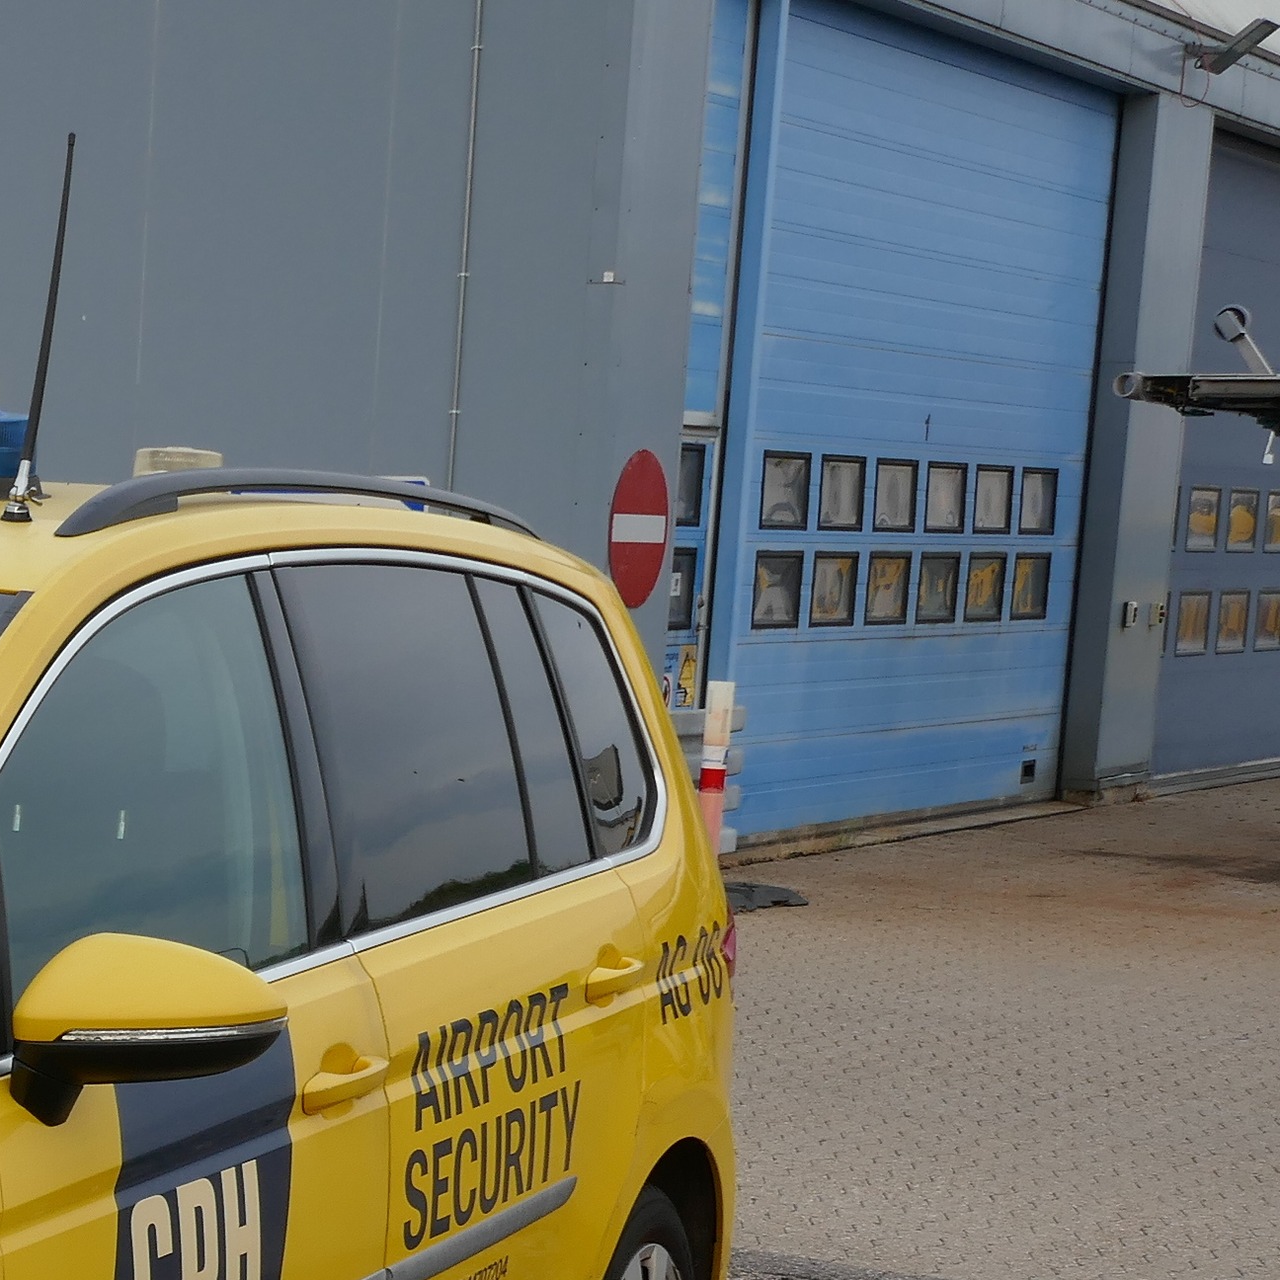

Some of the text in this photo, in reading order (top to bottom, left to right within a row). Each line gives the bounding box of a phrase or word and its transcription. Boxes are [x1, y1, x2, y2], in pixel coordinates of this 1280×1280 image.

[655, 920, 723, 1026] AG 06
[410, 982, 569, 1133] AIRPORT
[403, 1079, 582, 1251] SECURITY
